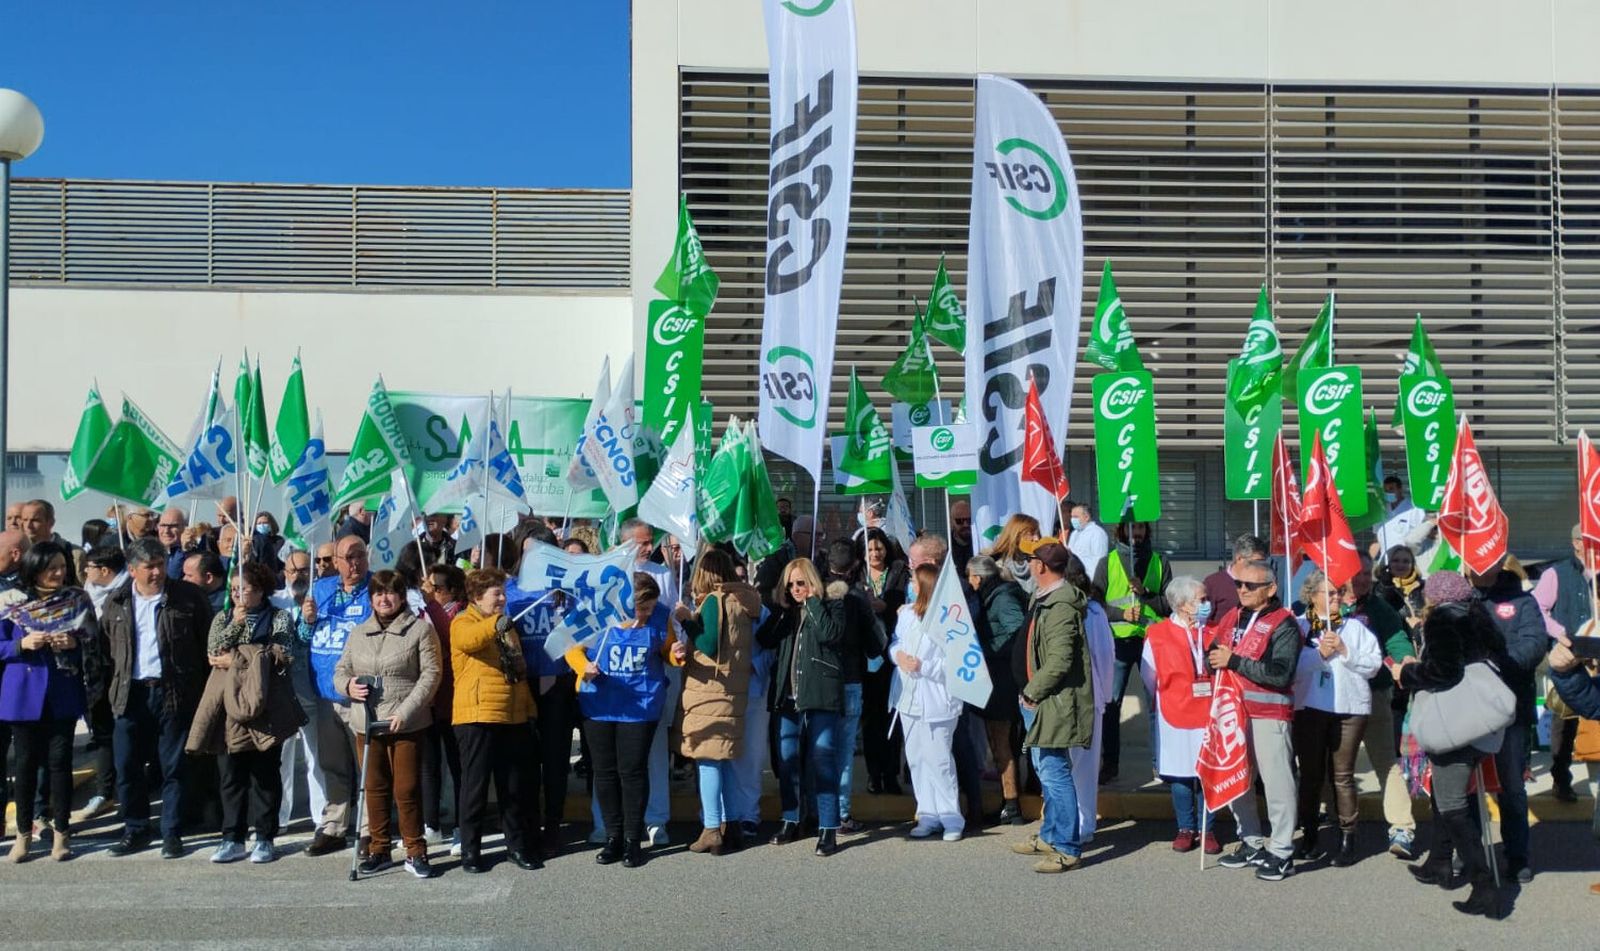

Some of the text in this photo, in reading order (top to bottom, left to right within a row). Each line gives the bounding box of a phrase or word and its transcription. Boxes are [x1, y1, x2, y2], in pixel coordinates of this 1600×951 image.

[660, 351, 684, 441] CSIF
[1118, 423, 1138, 517] CSIF
[1244, 404, 1263, 495] CSIF
[1424, 421, 1447, 505] CSIF
